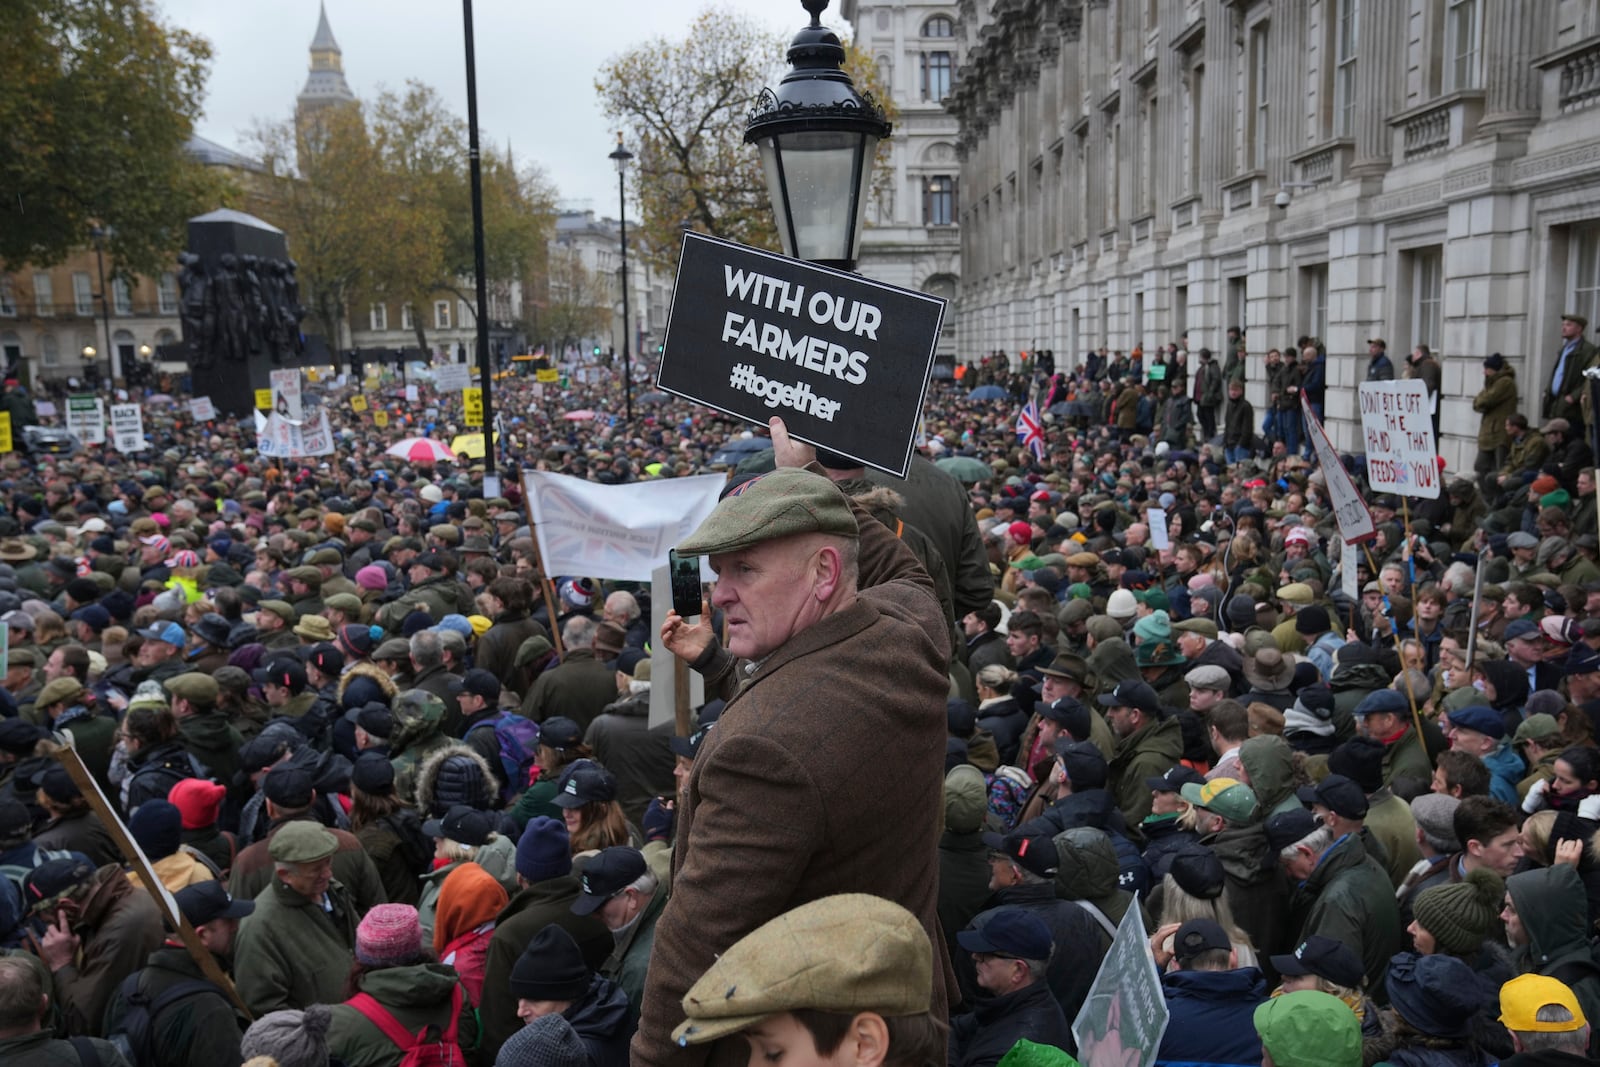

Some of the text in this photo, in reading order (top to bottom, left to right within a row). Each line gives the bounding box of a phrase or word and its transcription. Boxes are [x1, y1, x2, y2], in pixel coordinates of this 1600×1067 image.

[723, 264, 882, 341] WITH OUR
[721, 311, 870, 385] FARMERS
[729, 362, 841, 422] #together
[1382, 392, 1403, 412] BITE
[1405, 393, 1421, 414] OFF
[1367, 425, 1429, 453] HAND THAT
[1384, 413, 1406, 431] THE
[1370, 457, 1437, 489] FEEDS YOU!
[1136, 967, 1156, 1025] FARMS
